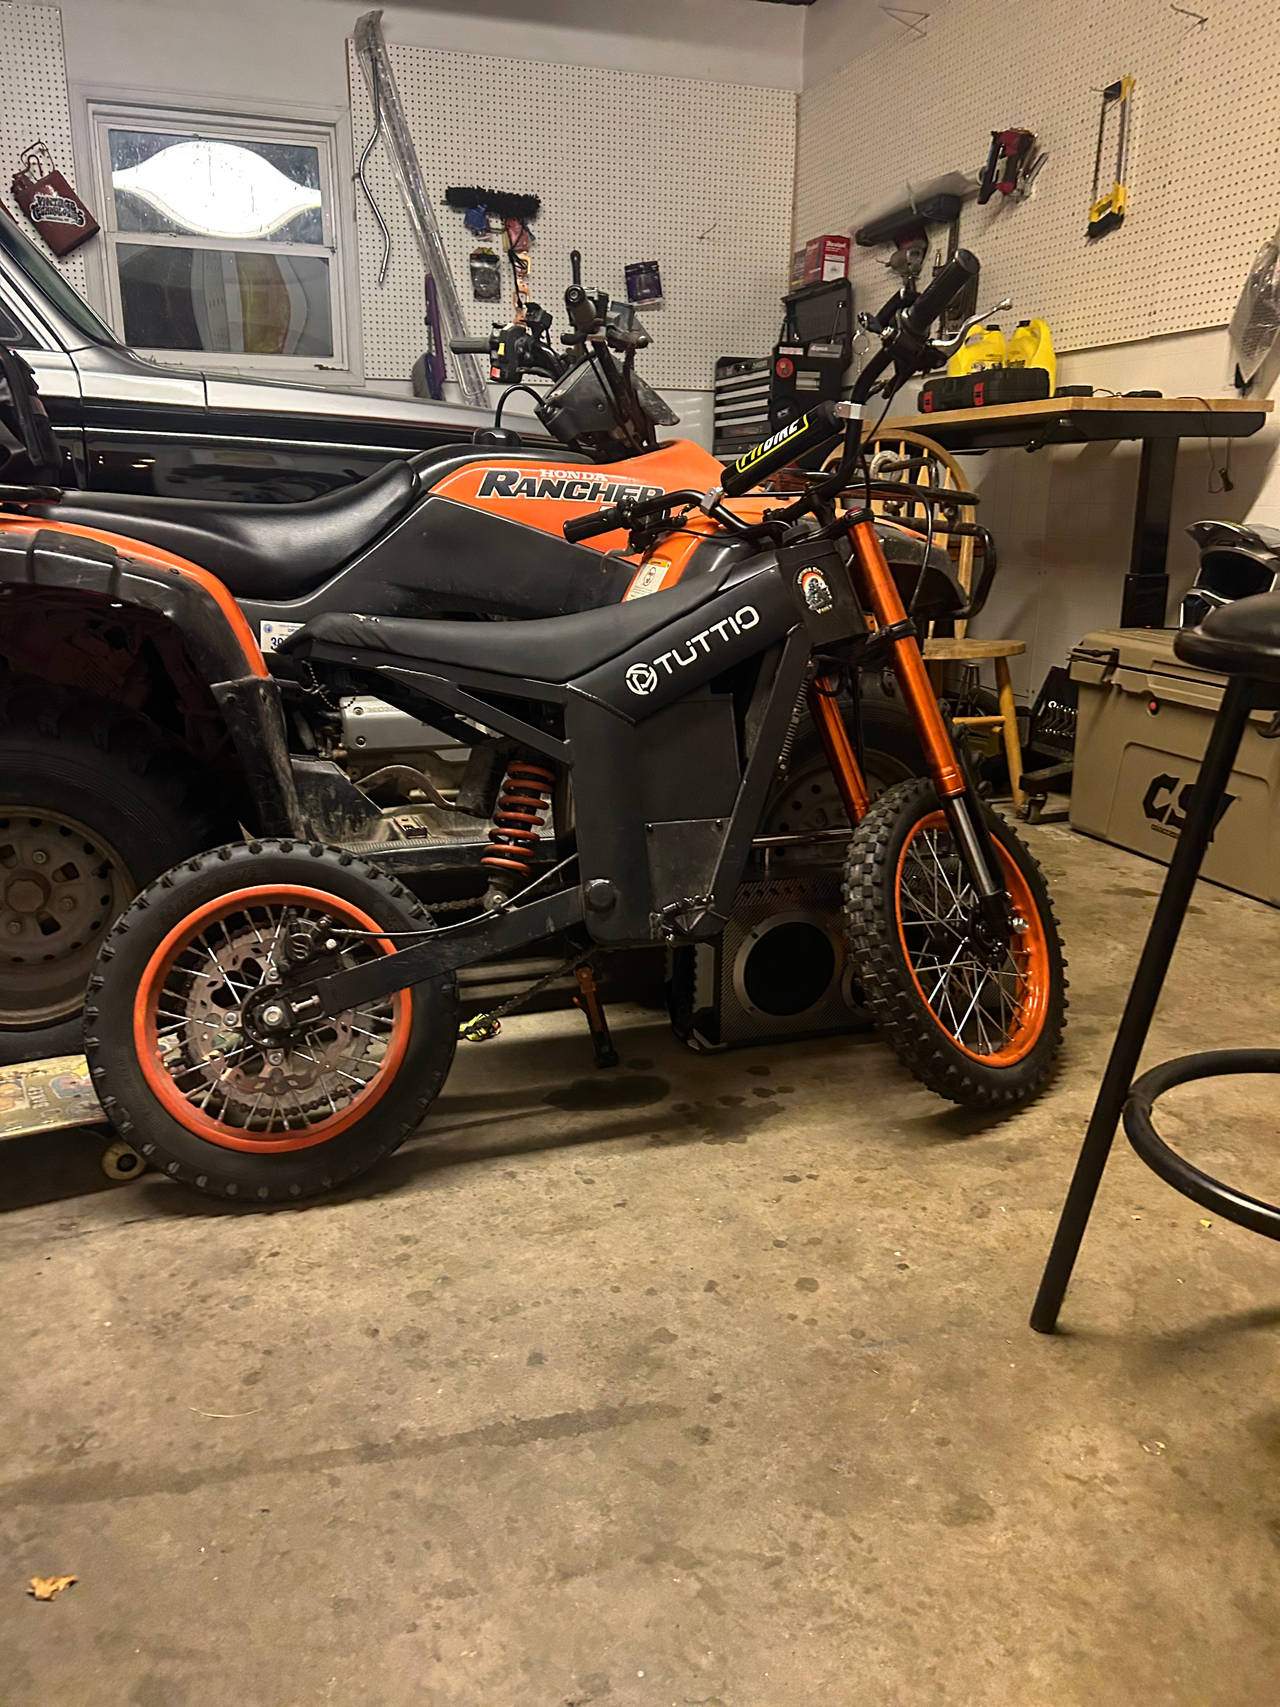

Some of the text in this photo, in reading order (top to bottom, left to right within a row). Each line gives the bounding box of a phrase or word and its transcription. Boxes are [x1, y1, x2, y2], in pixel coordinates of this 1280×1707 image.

[476, 468, 666, 505] RANCHER
[540, 468, 609, 482] HONDA
[652, 605, 760, 675] TUTTIO
